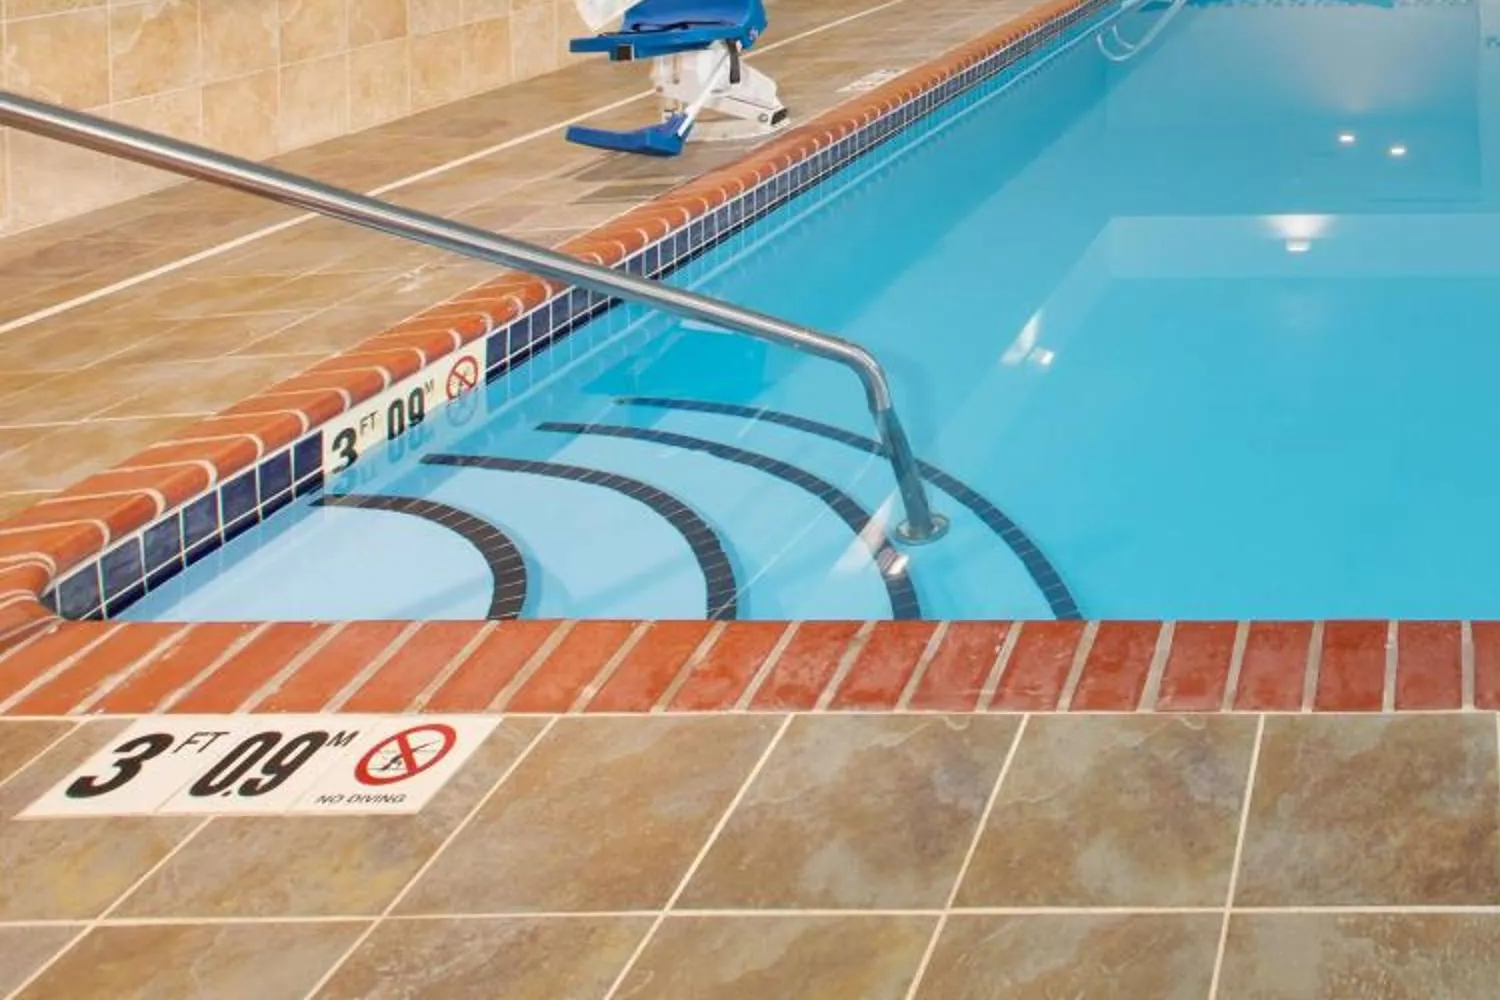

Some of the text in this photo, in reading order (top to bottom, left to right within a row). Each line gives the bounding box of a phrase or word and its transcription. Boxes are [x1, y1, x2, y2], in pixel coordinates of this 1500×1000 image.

[331, 427, 359, 474] 3
[359, 410, 379, 437] FT
[64, 729, 360, 799] 3 FT 0.9 M
